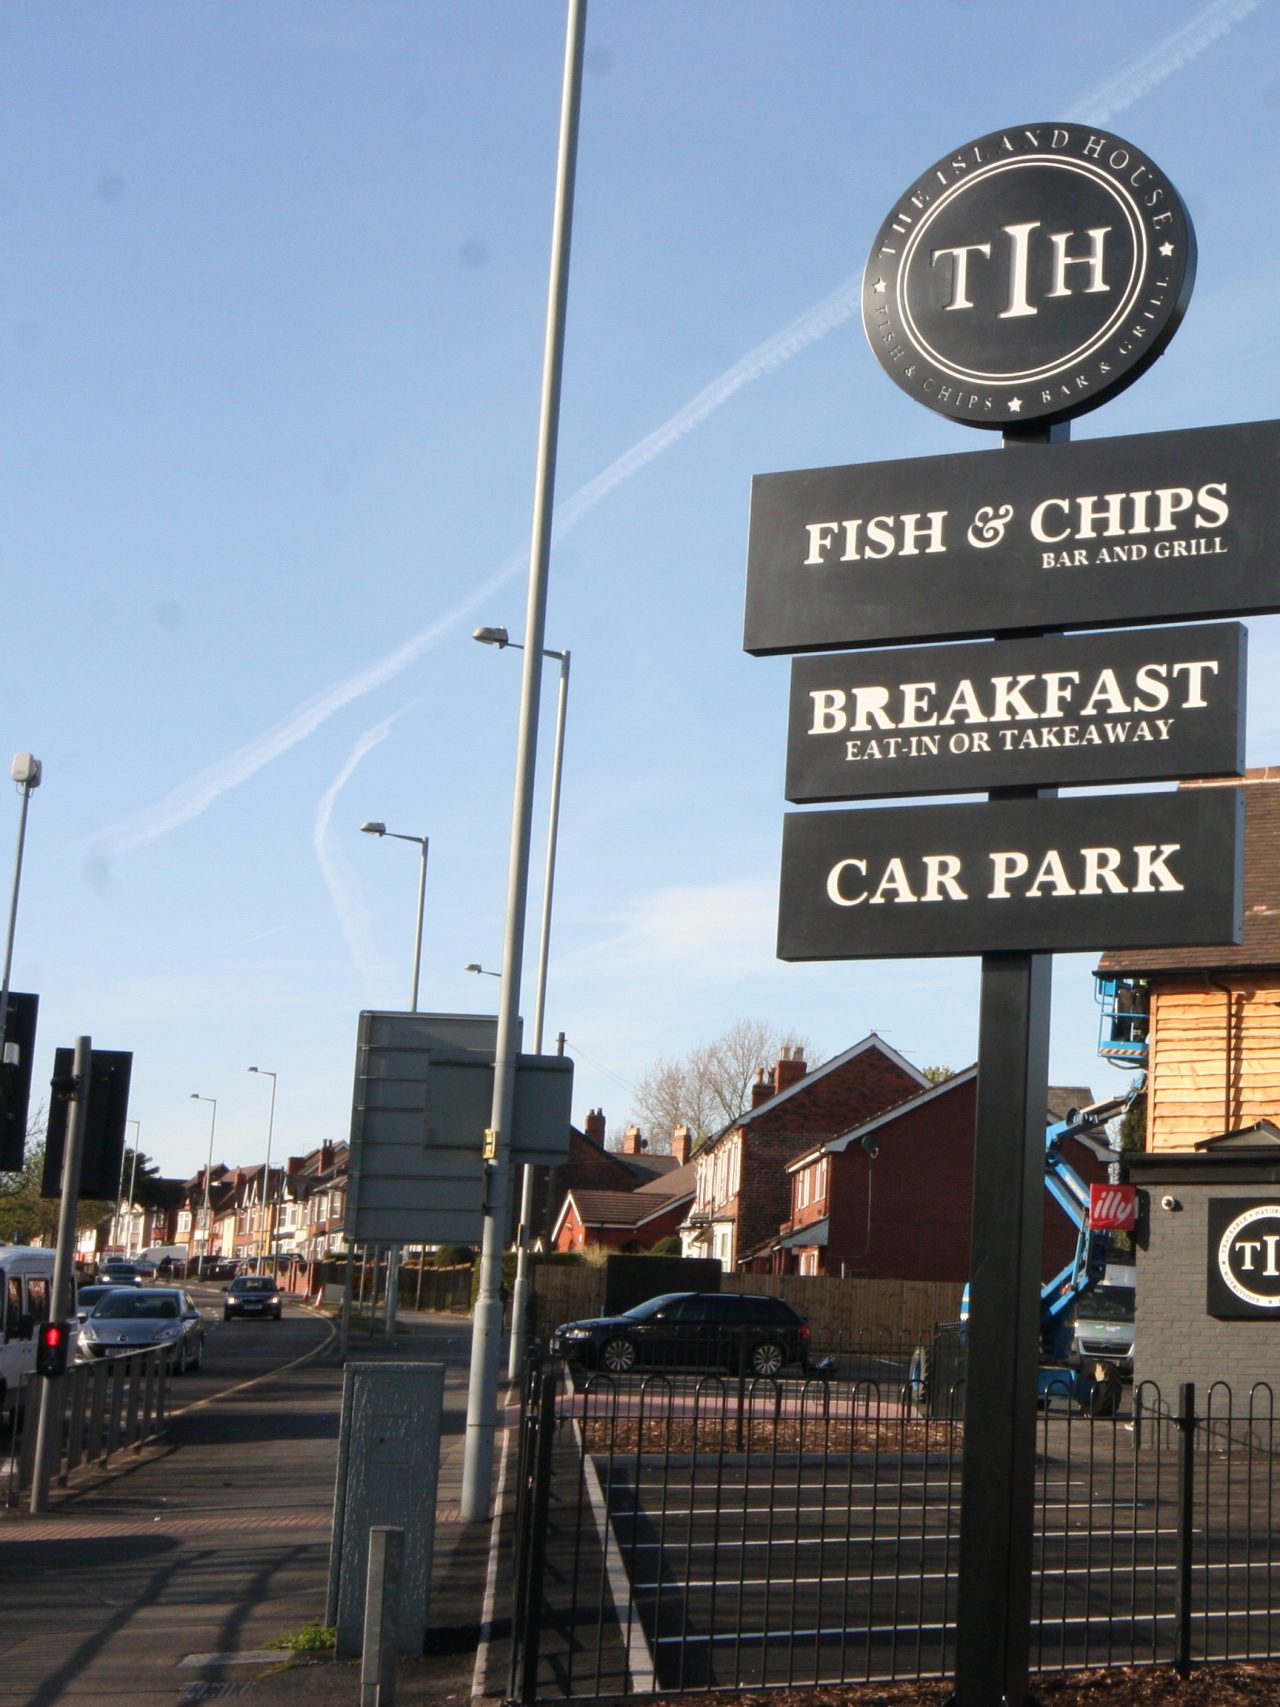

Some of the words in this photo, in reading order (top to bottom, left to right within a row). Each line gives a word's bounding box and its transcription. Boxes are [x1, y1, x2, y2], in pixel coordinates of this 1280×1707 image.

[877, 190, 929, 259] THE
[935, 129, 1069, 186] ISLAND
[1083, 135, 1173, 230] HOUSE
[930, 220, 1113, 319] TIH
[875, 304, 905, 361] FISH
[922, 377, 993, 411] CHIPS
[1041, 375, 1089, 403] BAR
[1118, 275, 1170, 355] GRILL
[803, 509, 949, 566] FISH
[966, 504, 1014, 549] &
[1029, 482, 1230, 543] CHIPS
[1041, 549, 1089, 569] BAR
[1095, 543, 1148, 564] AND
[1153, 536, 1229, 560] GRILL
[807, 660, 1219, 736] BREAKFAST
[844, 733, 940, 762] EAT-IN
[949, 731, 992, 755] OR
[999, 718, 1175, 751] TAKEAWAY
[825, 855, 969, 907] CAR
[987, 843, 1185, 900] PARK
[1093, 1190, 1132, 1226] illy
